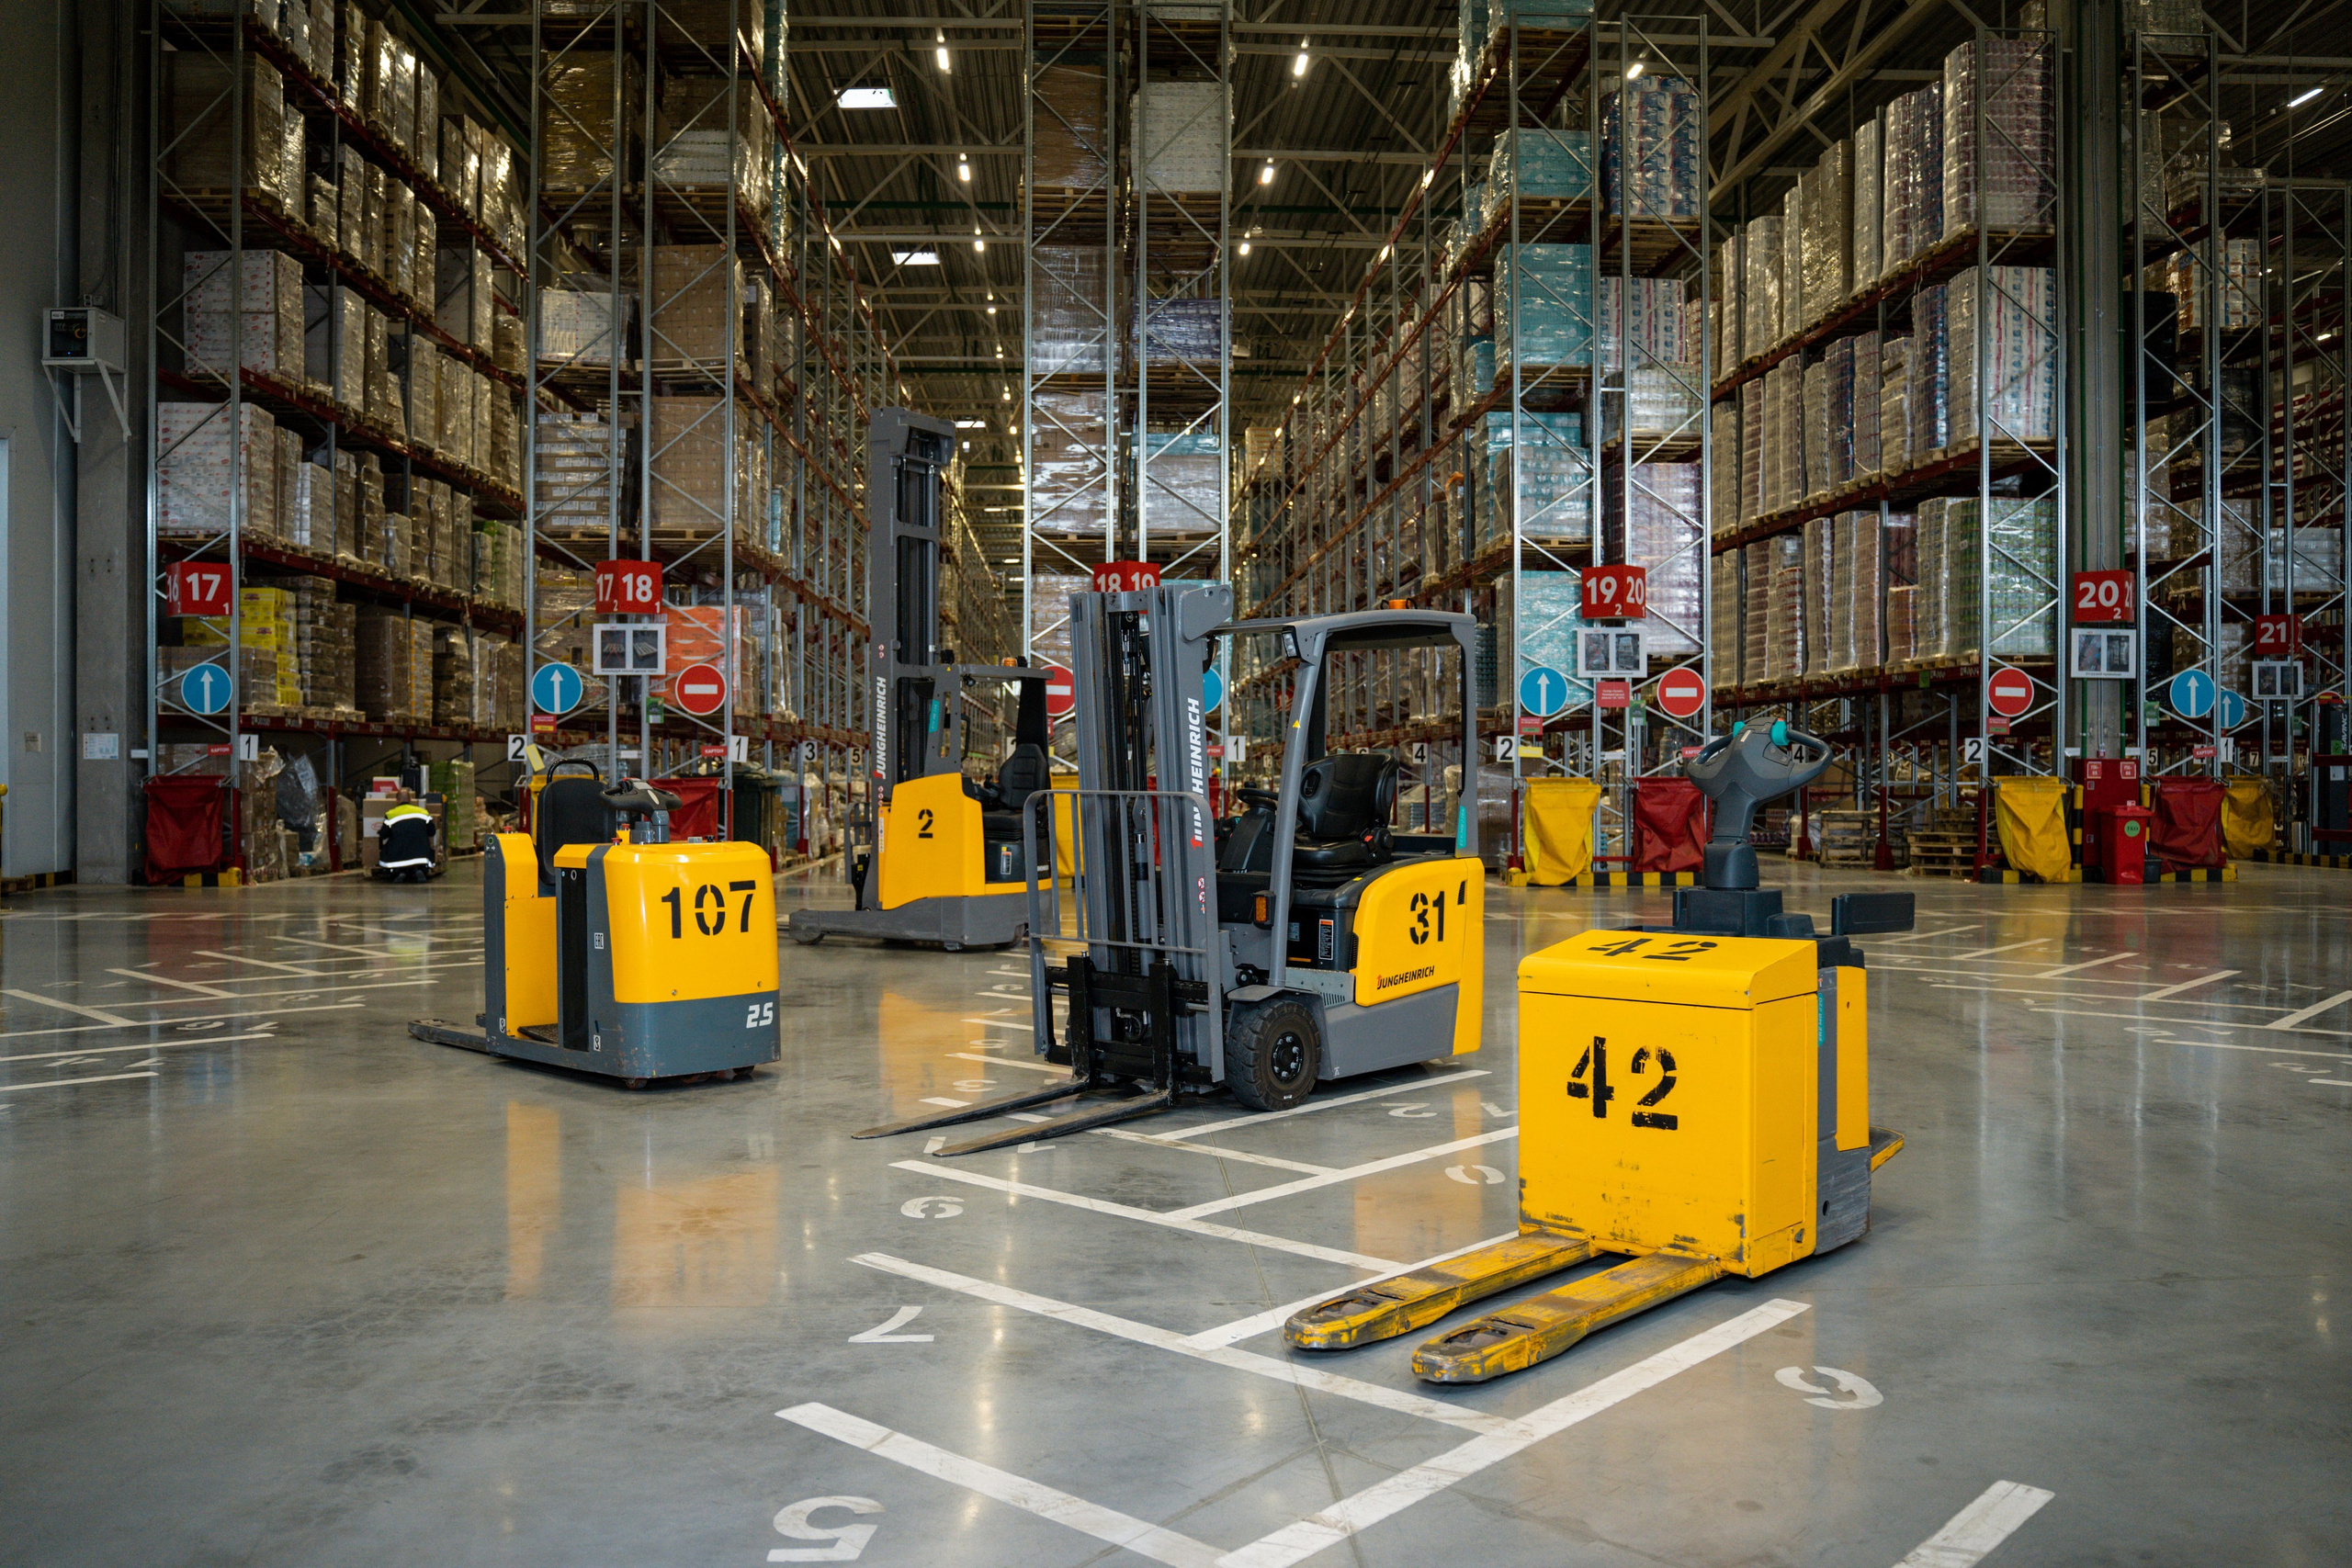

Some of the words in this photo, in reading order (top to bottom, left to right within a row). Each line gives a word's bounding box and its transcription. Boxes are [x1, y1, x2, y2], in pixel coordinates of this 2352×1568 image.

[166, 573, 179, 603] 16
[186, 572, 221, 602] 17
[597, 573, 614, 602] 17
[621, 572, 653, 603] 18
[1097, 572, 1121, 592] 18
[1586, 576, 1617, 604] 19
[1626, 575, 1645, 605] 20
[2078, 580, 2120, 608] 20
[223, 603, 230, 615] 1
[613, 601, 618, 612] 2
[654, 602, 661, 614] 1
[1614, 604, 1623, 615] 2
[2113, 607, 2121, 619] 2
[2259, 621, 2287, 644] 21
[873, 676, 887, 780] JUNGHEINRICH
[244, 736, 252, 760] 1
[511, 736, 526, 760] 2
[735, 738, 742, 761] 1
[804, 742, 816, 761] 3
[852, 748, 861, 763] 5
[1233, 737, 1239, 761] 1
[1414, 744, 1426, 762] 4
[1499, 738, 1513, 761] 2
[1793, 745, 1804, 763] 4
[1967, 739, 1982, 762] 2
[2147, 750, 2156, 764] 5
[2223, 739, 2229, 761] 1
[2251, 752, 2258, 764] 7
[918, 808, 934, 839] 2
[661, 880, 757, 939] 107
[1409, 891, 1445, 946] 31
[1587, 937, 1718, 960] 42
[1376, 965, 1435, 990] JUNGHEINRICH
[1566, 1035, 1679, 1131] 42
[1444, 1164, 1507, 1185] 0
[847, 1305, 935, 1344] 7
[766, 1495, 887, 1563] 5
